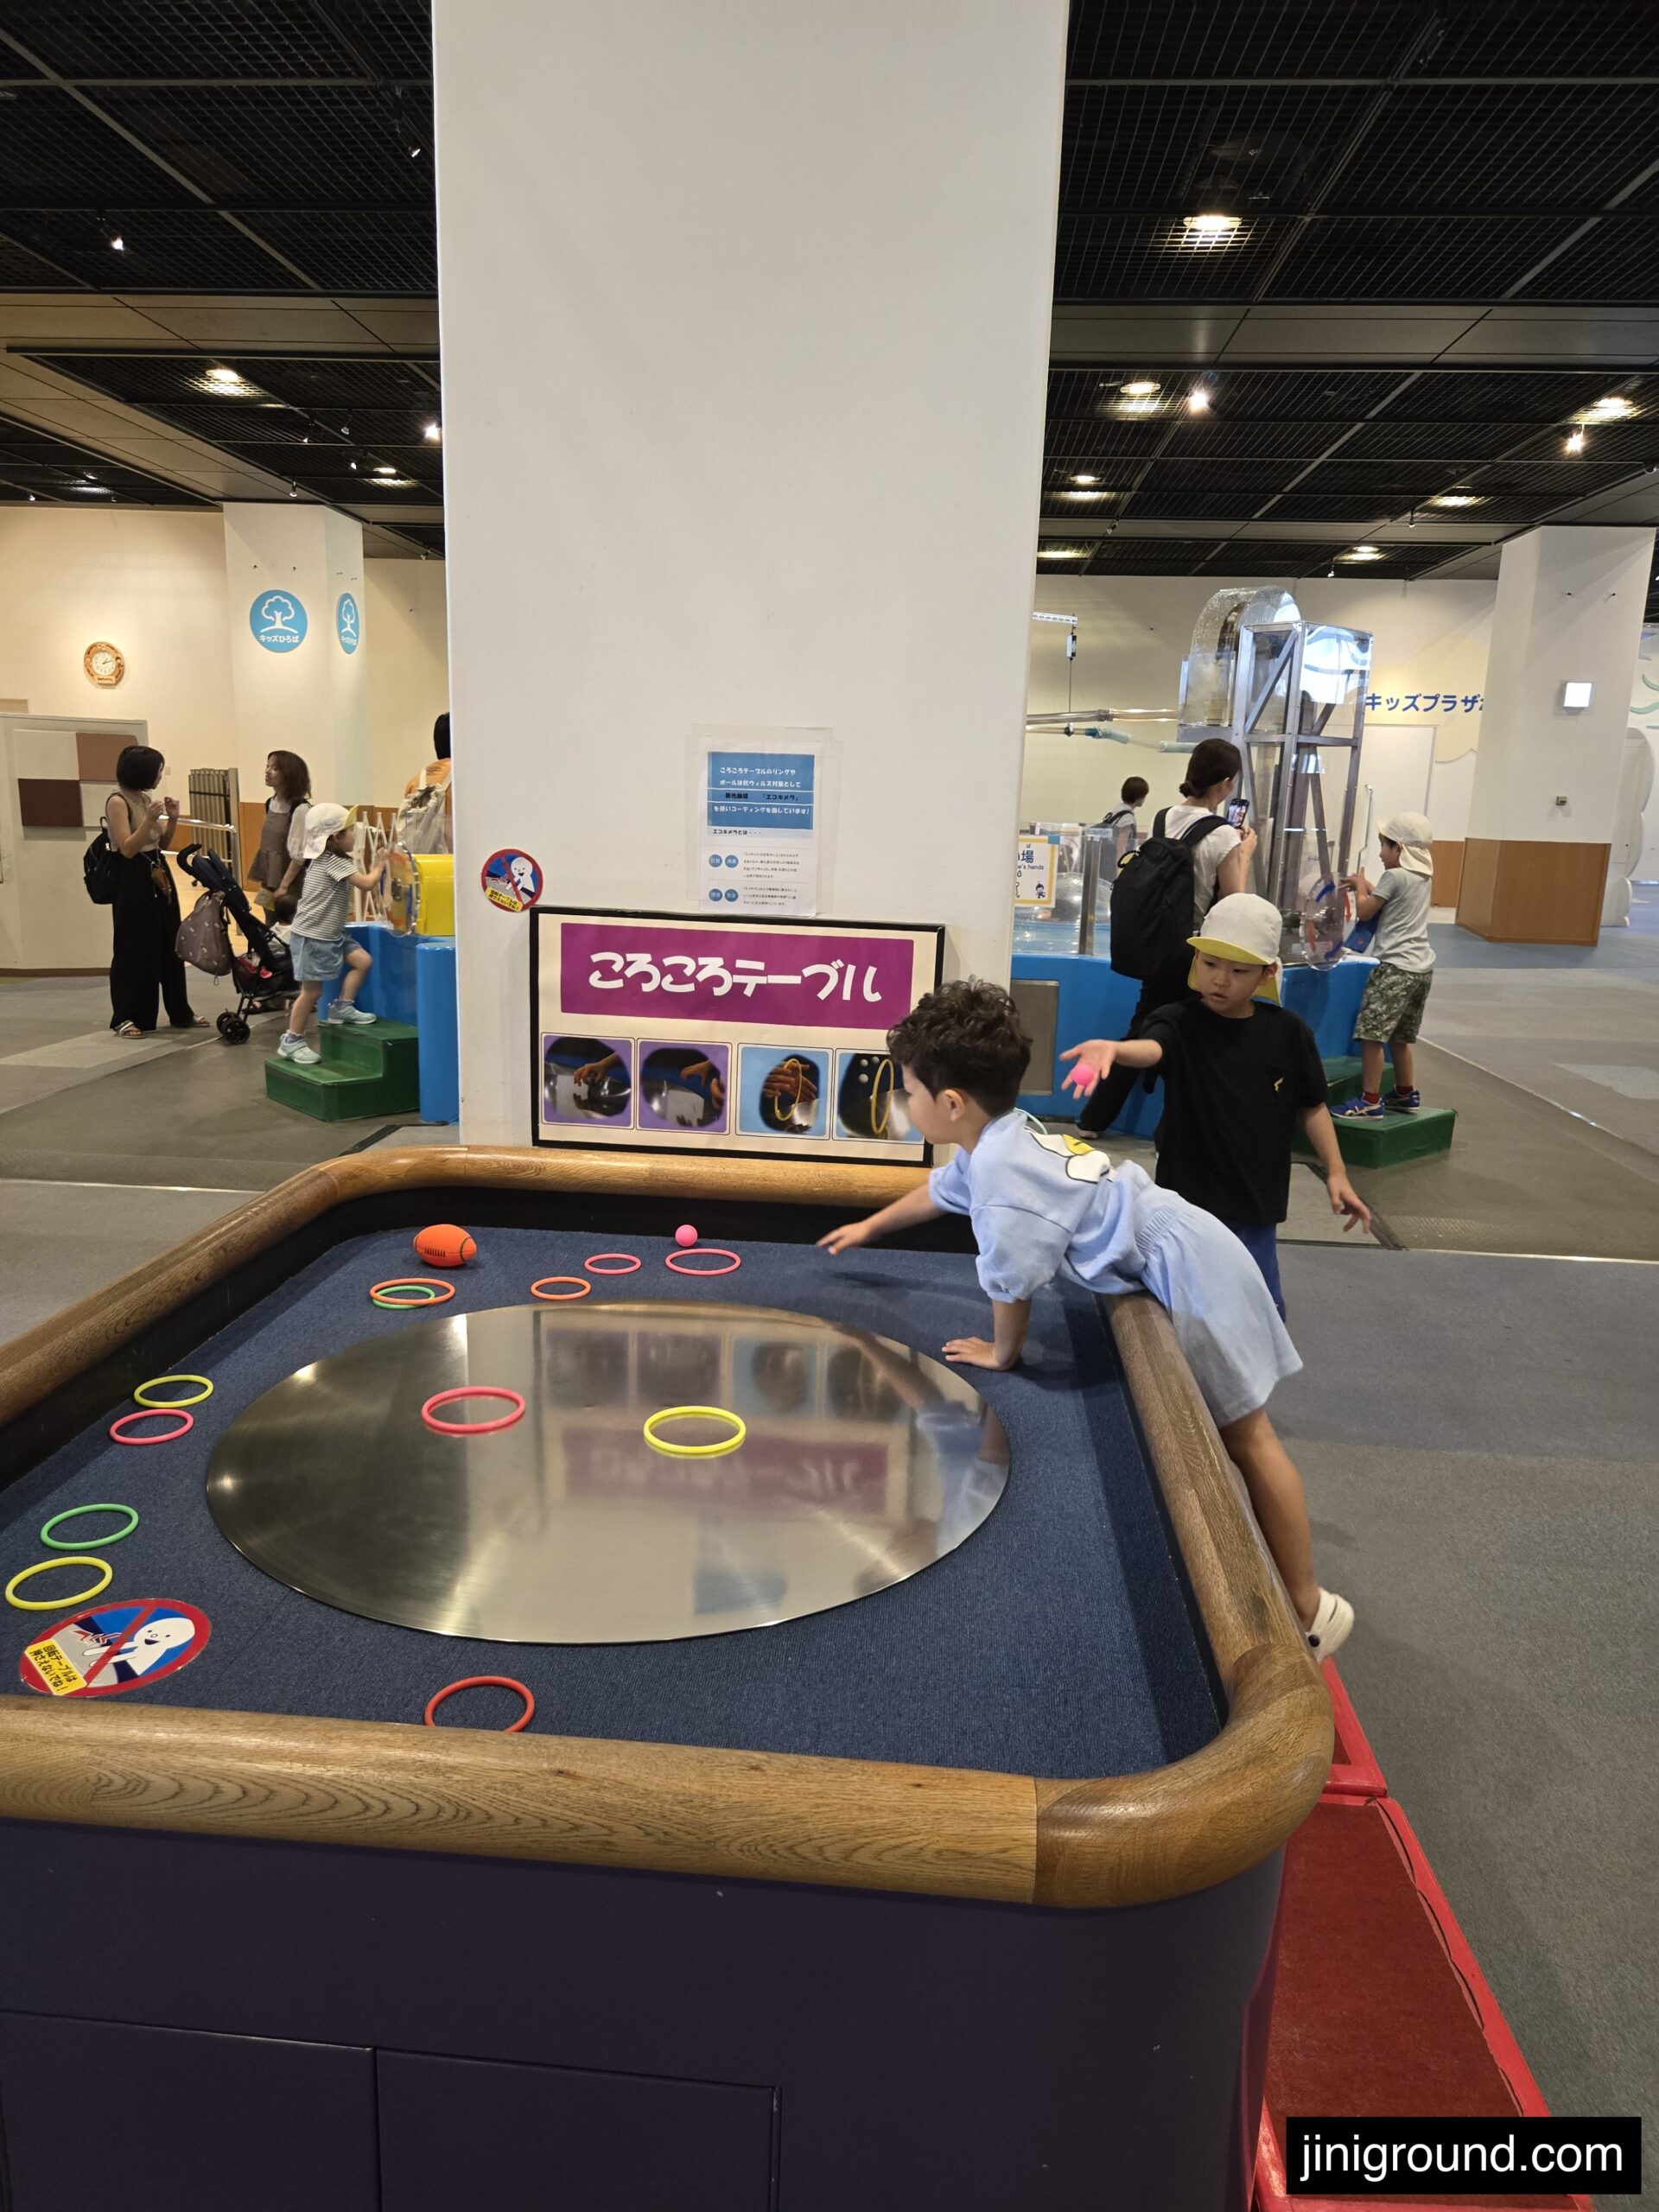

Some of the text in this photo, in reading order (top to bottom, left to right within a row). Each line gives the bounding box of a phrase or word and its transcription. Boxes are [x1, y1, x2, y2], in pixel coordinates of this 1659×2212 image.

[259, 634, 300, 644] キッズひろば
[1365, 693, 1484, 713] キッズプラザ
[1018, 850, 1033, 863] 場
[588, 952, 882, 1002] ころころテーブル
[43, 1644, 77, 1682] 回転テーブルは
